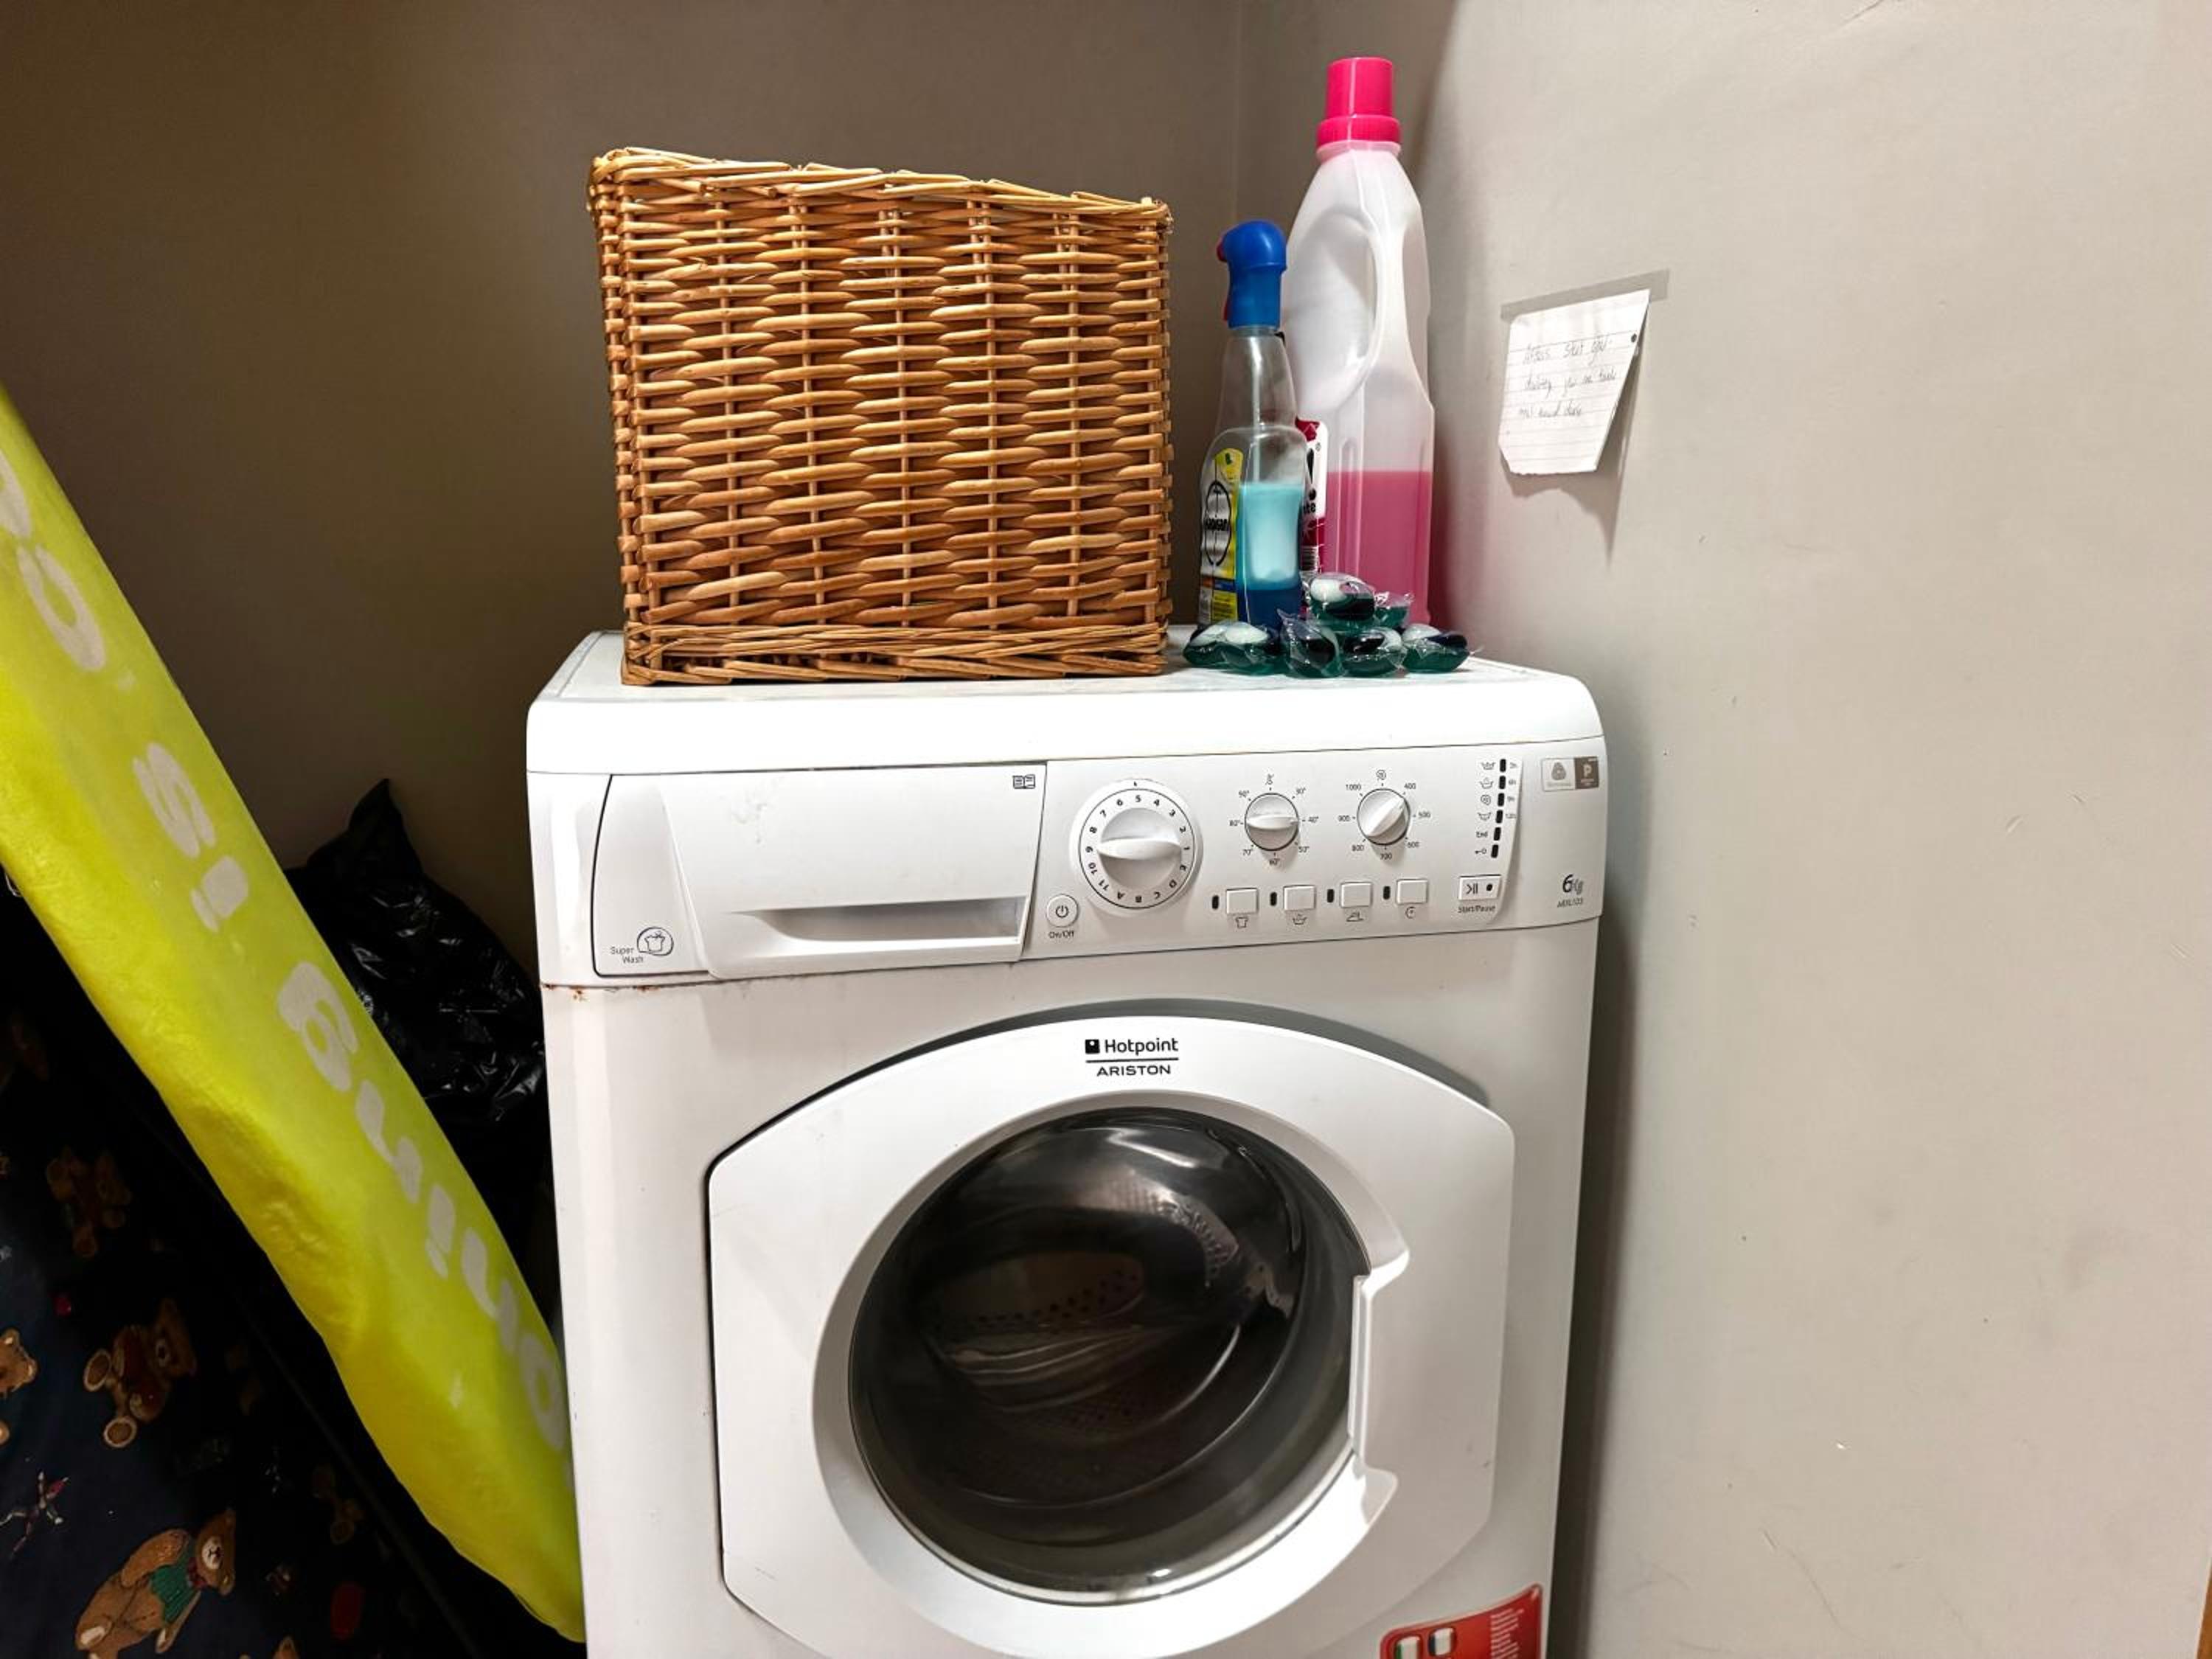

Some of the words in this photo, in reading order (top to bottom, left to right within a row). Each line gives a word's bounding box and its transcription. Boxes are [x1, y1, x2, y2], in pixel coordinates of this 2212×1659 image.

[1116, 799, 1124, 807] 6
[1153, 799, 1160, 807] 4
[1099, 810, 1107, 818] 7
[1169, 809, 1176, 817] 3
[1089, 826, 1097, 834] 8
[131, 742, 249, 933] is
[1088, 862, 1098, 875] 10
[1099, 880, 1110, 891] 11
[610, 946, 634, 955] Super
[622, 956, 644, 964] Wash
[1105, 1037, 1179, 1056] Hotpoint
[1096, 1064, 1171, 1077] ARISTON
[277, 961, 577, 1497] oning
